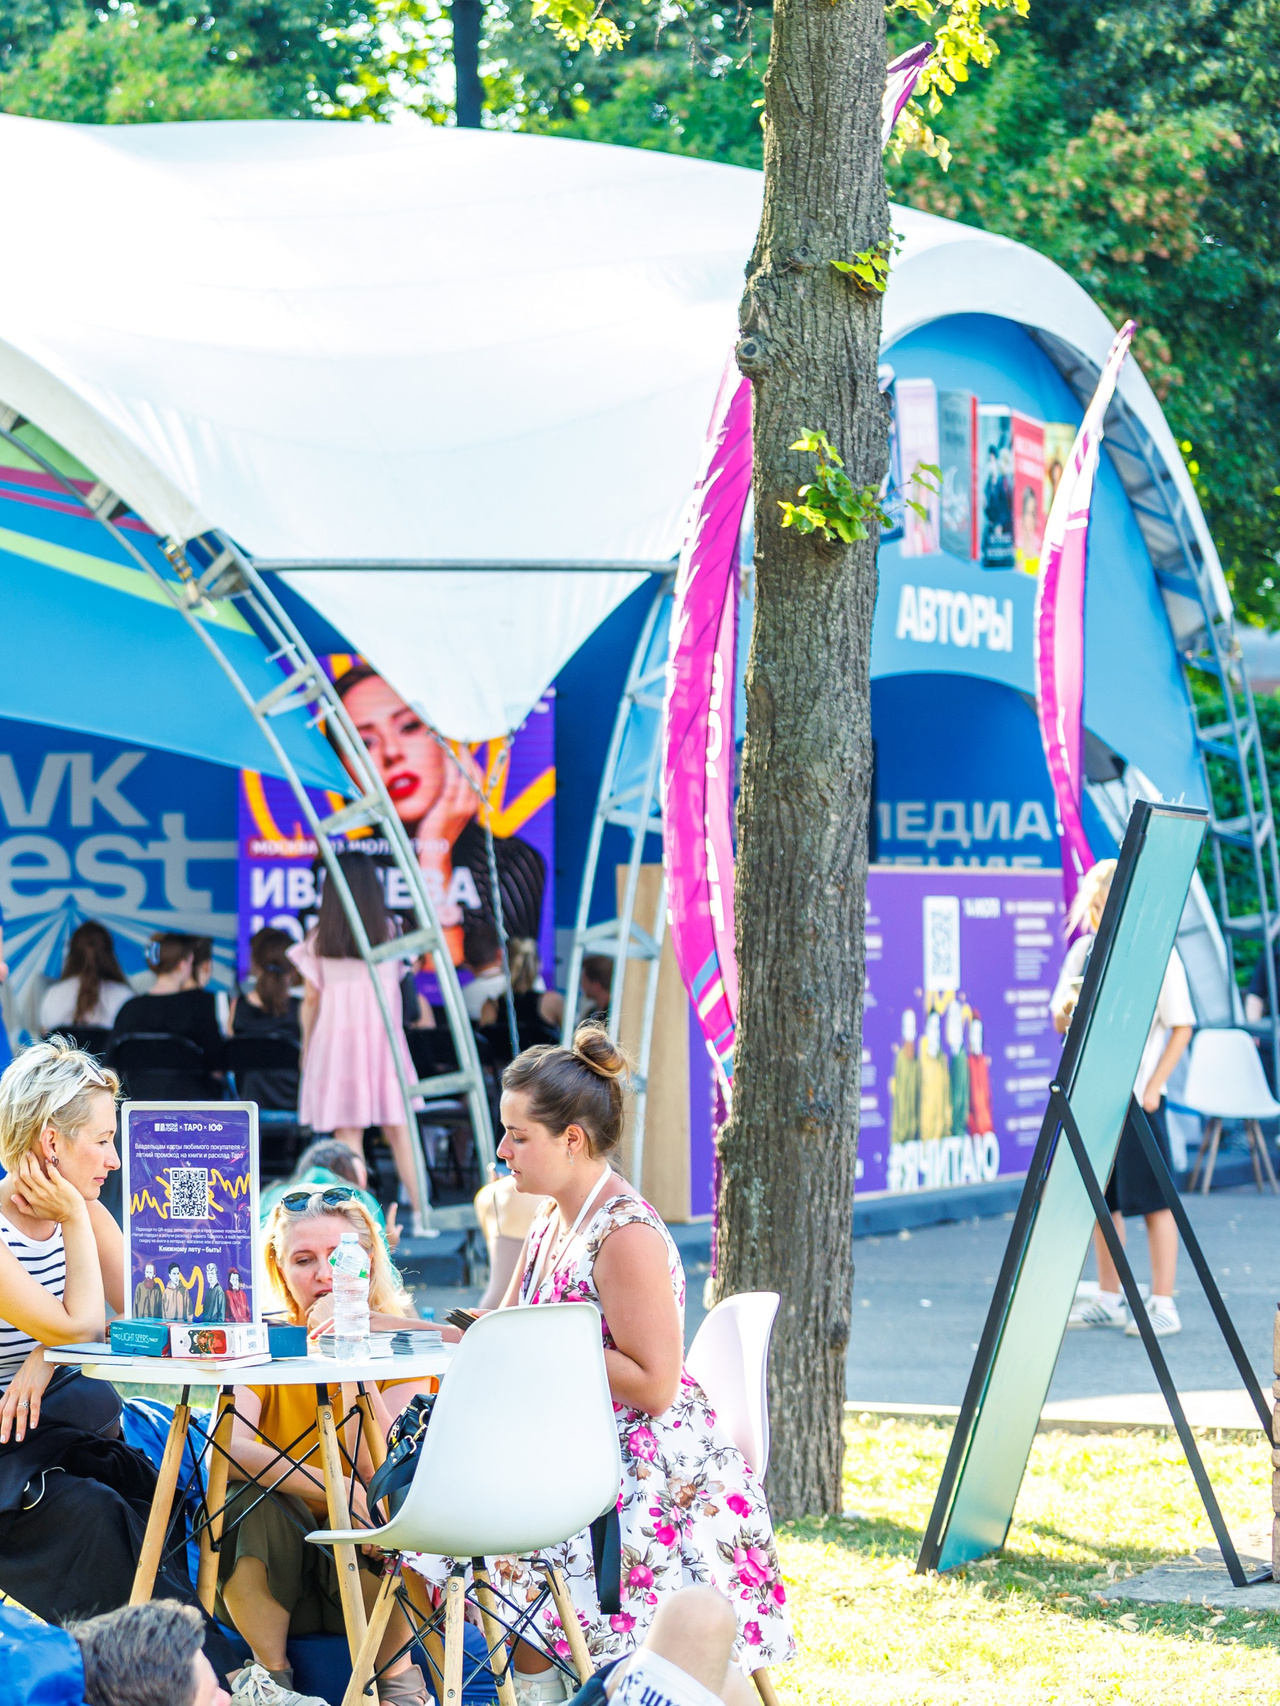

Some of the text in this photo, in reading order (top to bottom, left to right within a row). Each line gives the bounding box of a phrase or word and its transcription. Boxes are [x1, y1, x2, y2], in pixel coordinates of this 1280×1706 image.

[895, 583, 1014, 653] АВТОРЫ
[347, 838, 396, 855] ИЮЛ
[250, 866, 482, 910] ИВЕВА
[184, 1123, 203, 1132] ТАРО
[208, 1123, 223, 1132] ЮФ
[887, 1131, 1000, 1192] #ЯЧИТАЮ
[159, 1245, 187, 1253] Книжному
